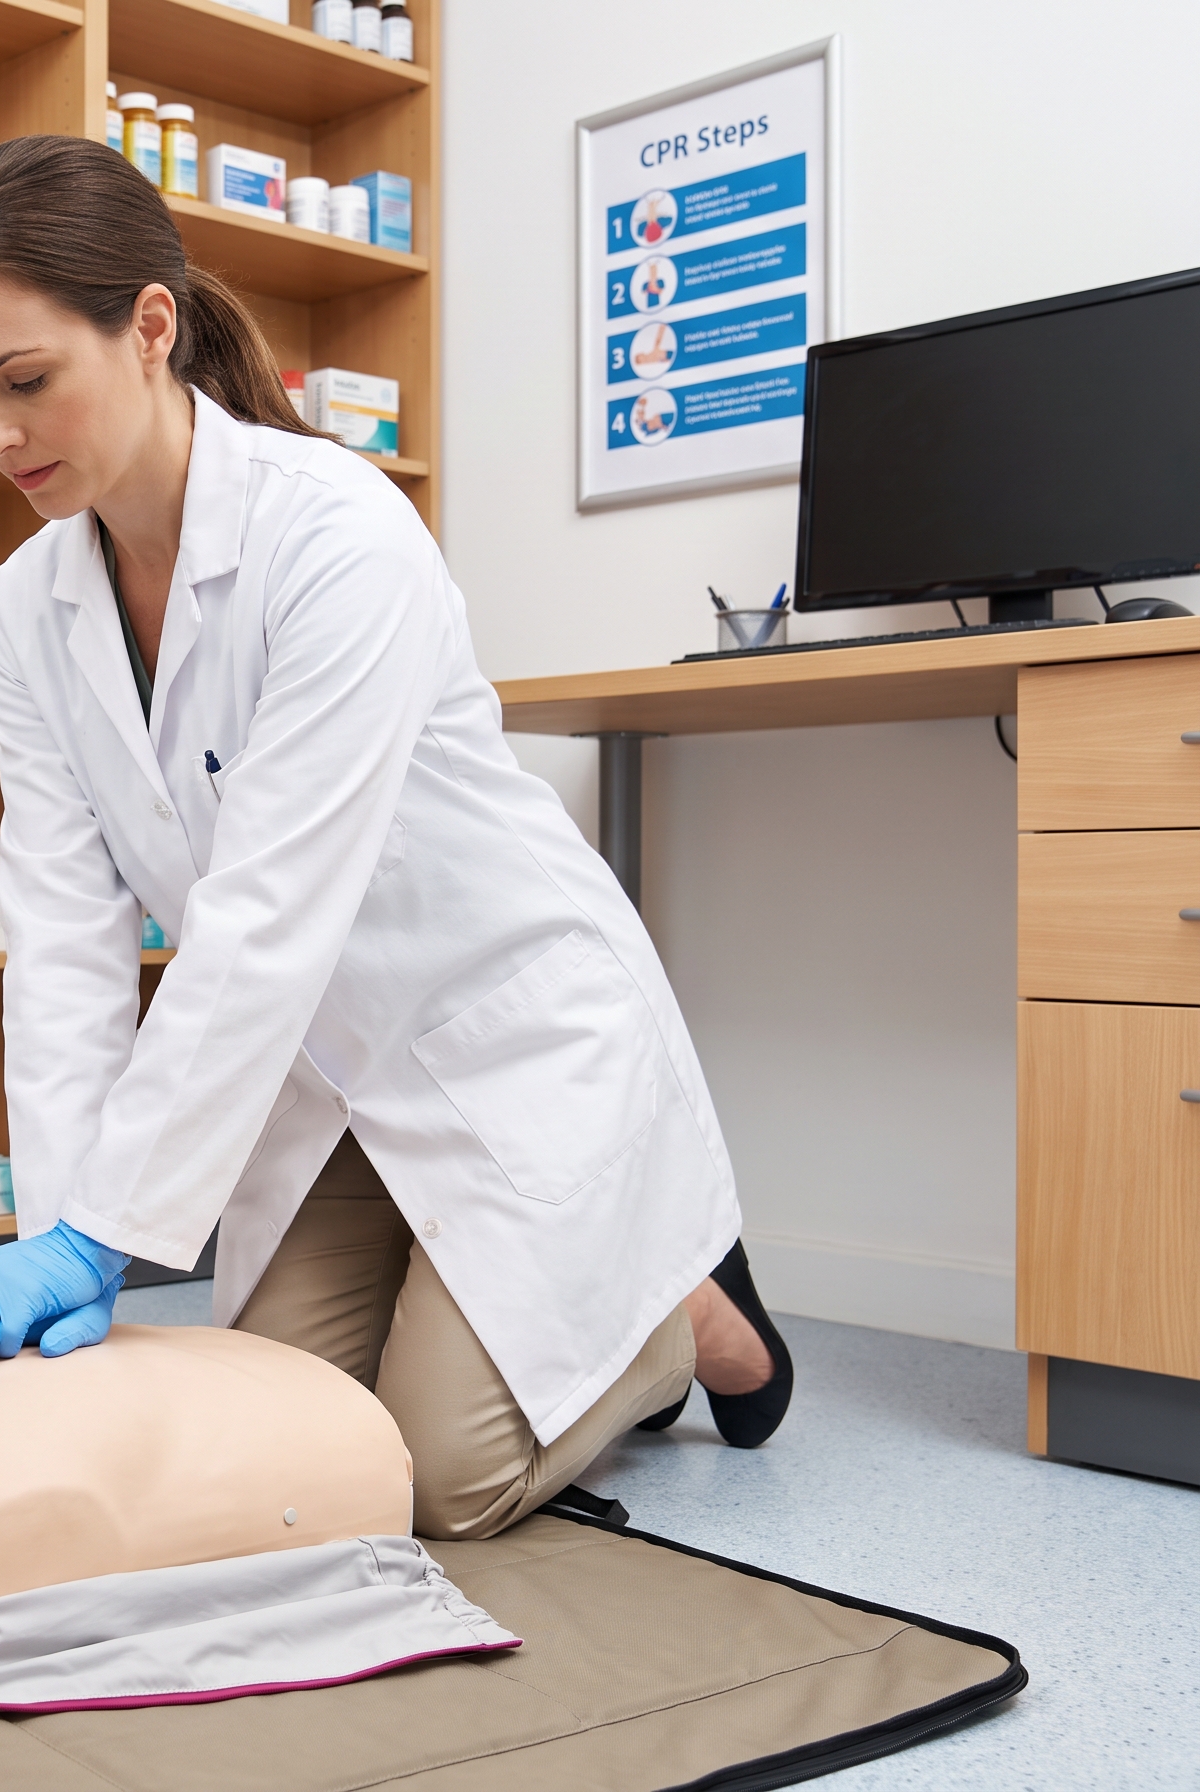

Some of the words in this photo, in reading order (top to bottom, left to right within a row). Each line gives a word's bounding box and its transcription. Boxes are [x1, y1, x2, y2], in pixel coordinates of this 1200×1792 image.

[640, 134, 688, 168] CPR
[697, 115, 769, 153] Steps
[612, 217, 623, 239] 1
[611, 282, 626, 306] 2
[611, 347, 625, 370] 3
[611, 412, 626, 434] 4
